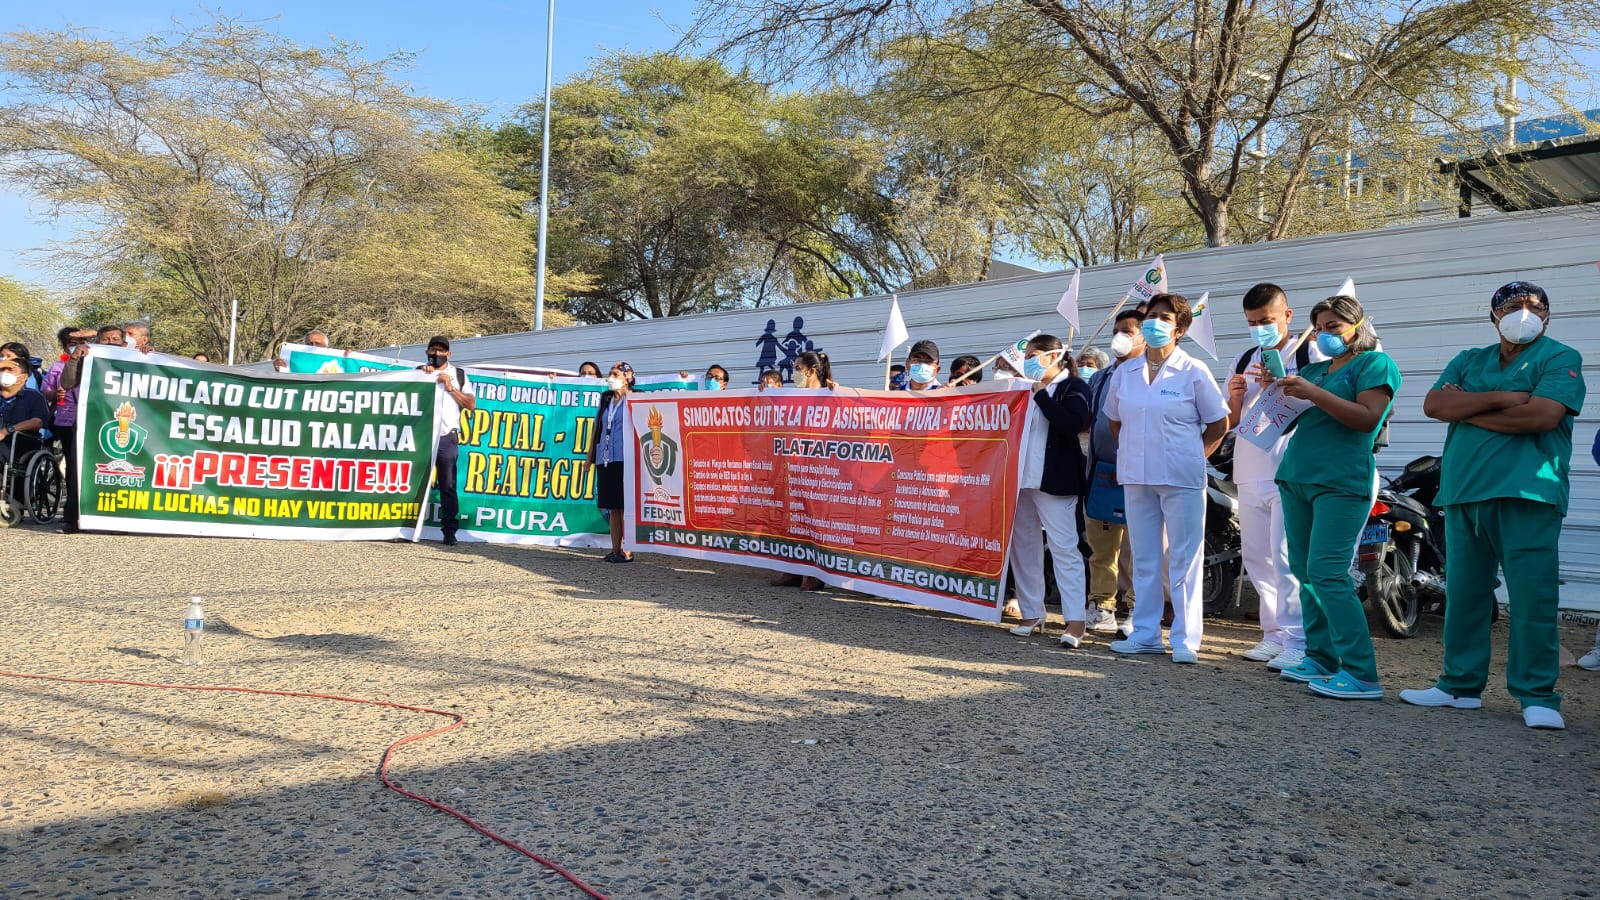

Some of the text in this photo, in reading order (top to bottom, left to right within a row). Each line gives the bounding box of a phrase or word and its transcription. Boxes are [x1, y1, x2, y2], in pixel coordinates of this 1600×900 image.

[104, 370, 423, 417] SINDICATO CUT HOSPITAL
[510, 385, 557, 406] UNIÓN
[560, 390, 580, 407] DE
[459, 407, 545, 452] SPITAL
[683, 406, 752, 428] SINDICATOS
[753, 405, 772, 427] CUT
[773, 405, 787, 427] DE
[787, 405, 801, 427] LA
[804, 406, 830, 429] RED
[831, 404, 902, 430] ASISTENCIAL
[904, 406, 941, 431] PIURA
[949, 403, 1011, 431] ESSALUD
[169, 411, 416, 452] ESSALUD TALARA
[772, 437, 895, 464] PLATAFORMA
[95, 474, 145, 488] FED-CUT
[465, 451, 596, 500] REATEGUI
[154, 494, 230, 516] LUCHAS
[233, 496, 261, 518] NO
[264, 497, 304, 520] HAY
[307, 500, 420, 522] VICTORIAS!!!
[475, 506, 569, 532] PIURA
[644, 507, 682, 521] FED-CUT
[648, 530, 673, 544] ¡SI
[674, 531, 697, 546] NO
[701, 534, 734, 551] HAY
[816, 551, 886, 580] HUELGA
[890, 566, 997, 601] REGIONAL!
